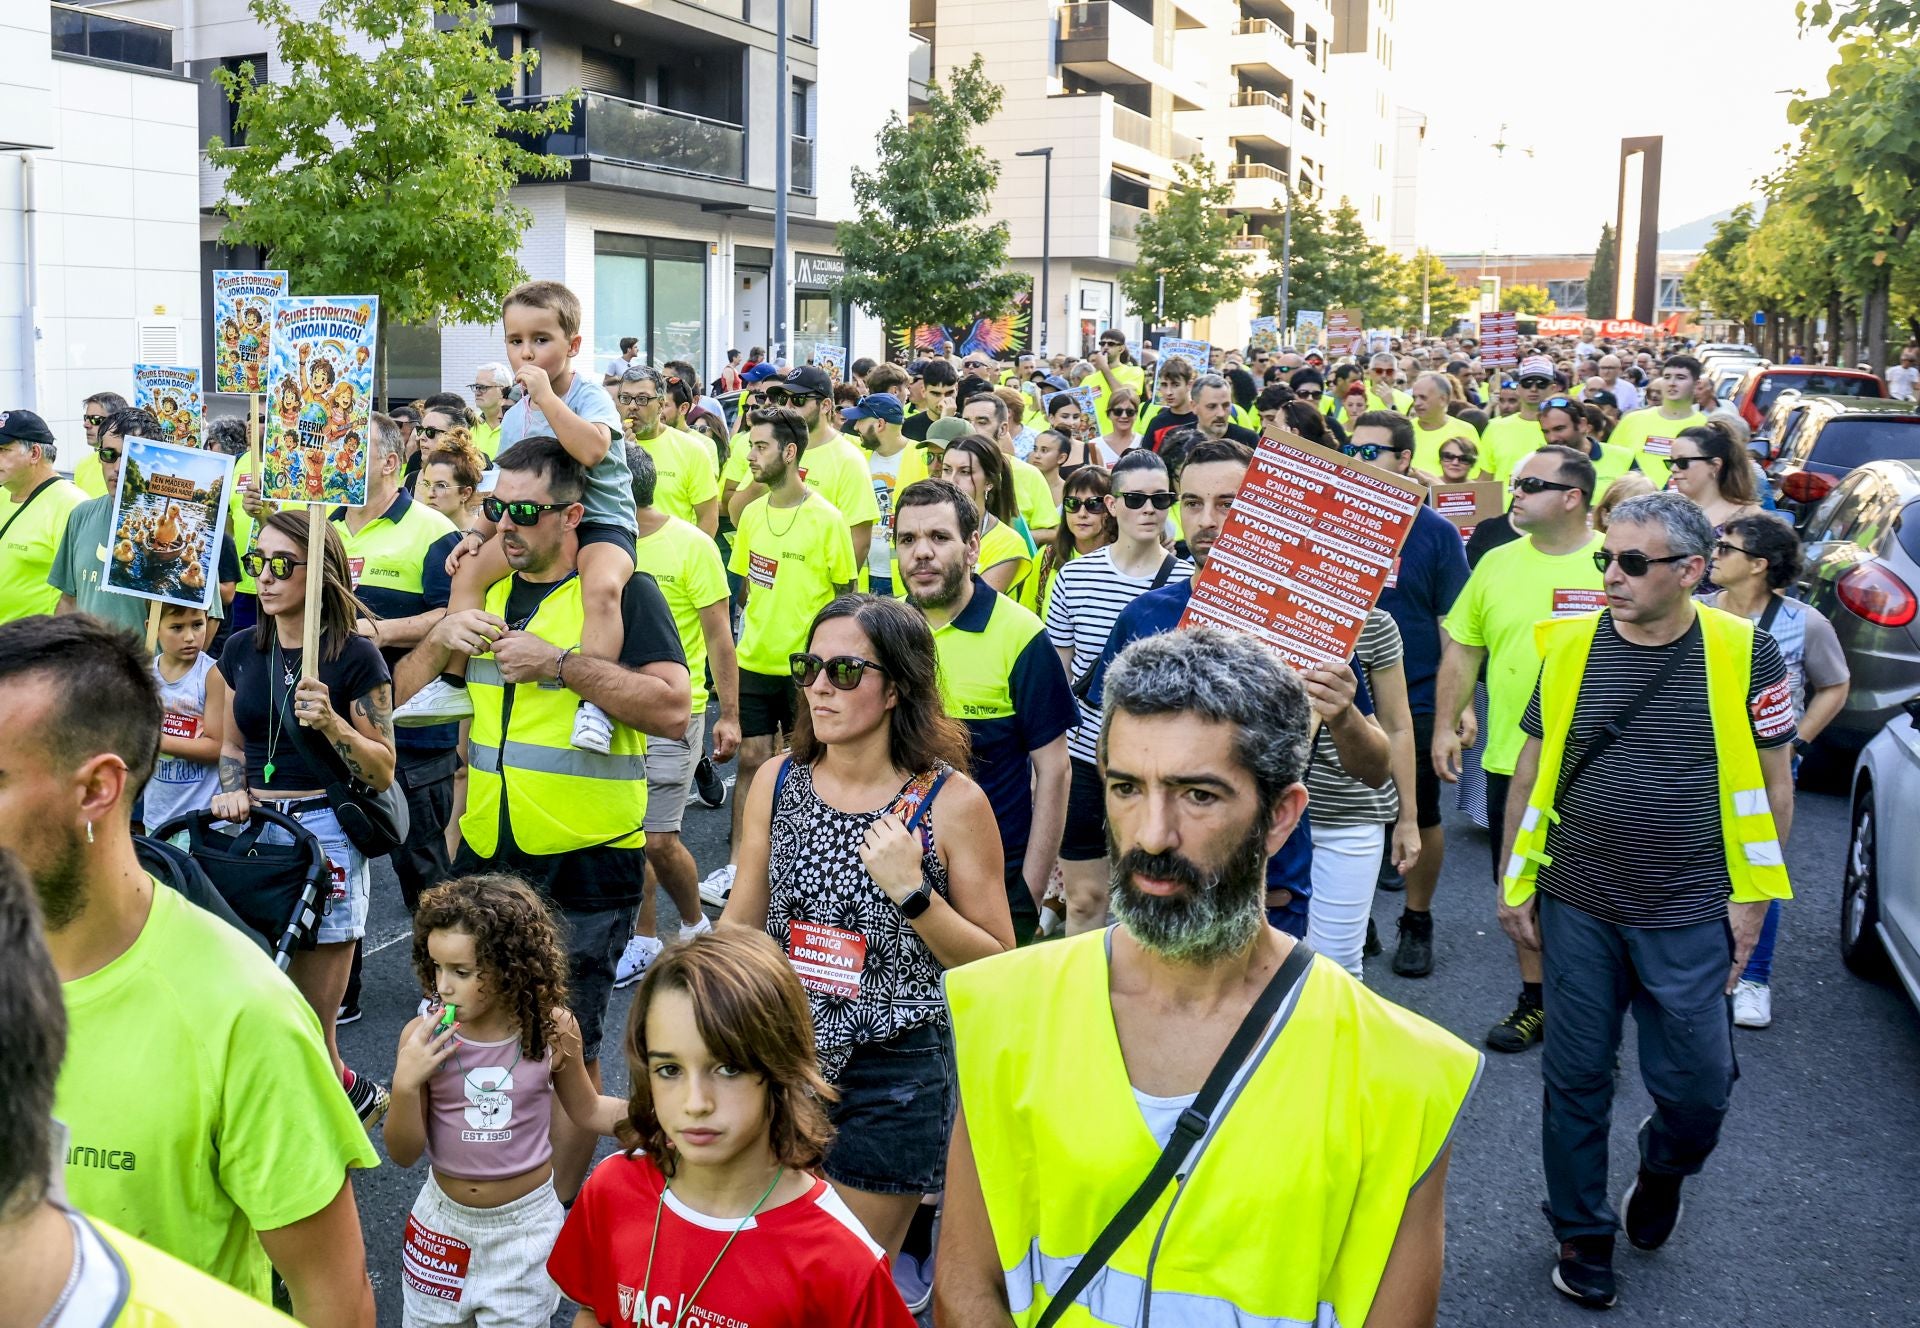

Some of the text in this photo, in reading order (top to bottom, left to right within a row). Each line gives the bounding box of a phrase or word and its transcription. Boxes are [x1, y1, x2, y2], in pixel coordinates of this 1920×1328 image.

[812, 258, 844, 272] AZCÚNAGA
[223, 276, 281, 290] GURE ETORKIZUNA
[227, 287, 278, 298] JOKOAN DAGO!
[284, 306, 367, 329] GURE ETORKIZUNA
[288, 323, 362, 344] JOKOAN DAGO!
[146, 379, 192, 391] JOKOAN DAGO!
[299, 420, 324, 433] ERERIK
[300, 433, 325, 450] EZ!!!
[1263, 438, 1336, 471] KALERATZERIK EZ!
[165, 479, 192, 489] MADERAS
[1256, 461, 1324, 494] BORROKAN
[1340, 467, 1415, 501] KALERATZERIK EZ!
[1245, 481, 1317, 514] MADERAS DE LLODIO
[1264, 478, 1306, 501] garnica
[1241, 490, 1313, 524] KALERATZERIK EZ!
[1333, 490, 1402, 524] BORROKAN
[1234, 512, 1300, 546] BORROKAN
[1321, 511, 1395, 544] MADERAS DE LLODIO
[1341, 507, 1383, 531] garnica
[1241, 529, 1282, 553] garnica
[1317, 520, 1392, 554] KALERATZERIK EZ!
[782, 552, 805, 562] garnica
[1217, 538, 1289, 573] KALERATZERIK EZ!
[1222, 532, 1294, 566] MADERAS DE LLODIO
[1310, 543, 1378, 577] BORROKAN
[369, 567, 400, 578] garnica
[1210, 561, 1275, 595] BORROKAN
[1298, 563, 1372, 597] MADERAS DE LLODIO
[1318, 560, 1360, 583] garnica
[1199, 580, 1269, 614] MADERAS DE LLODIO
[1217, 577, 1258, 601] garnica
[1294, 570, 1368, 606] KALERATZERIK EZ!
[1194, 588, 1266, 623] KALERATZERIK EZ!
[1287, 592, 1353, 628] BORROKAN
[1271, 620, 1286, 630] EZ!
[1275, 612, 1346, 647] MADERAS DE LLODIO
[1293, 609, 1335, 634] garnica
[963, 705, 998, 715] garnica
[163, 727, 190, 737] ROKAN
[165, 719, 183, 727] rnica
[158, 759, 204, 781] THE RUSH
[794, 923, 820, 934] MADERAS
[832, 931, 861, 942] LLODIO
[805, 934, 841, 950] garnica
[794, 946, 854, 968] BORROKAN
[837, 986, 852, 997] EZ!
[463, 1131, 511, 1141] EST. 1950
[66, 1146, 136, 1171] rnica
[414, 1233, 447, 1256] garnica
[428, 1233, 436, 1241] DE
[437, 1236, 466, 1250] LLODIO
[406, 1240, 458, 1274] BORROKAN
[440, 1290, 456, 1300] EZ!
[690, 1305, 726, 1325] ATHLETIC
[727, 1318, 749, 1328] CLUB
